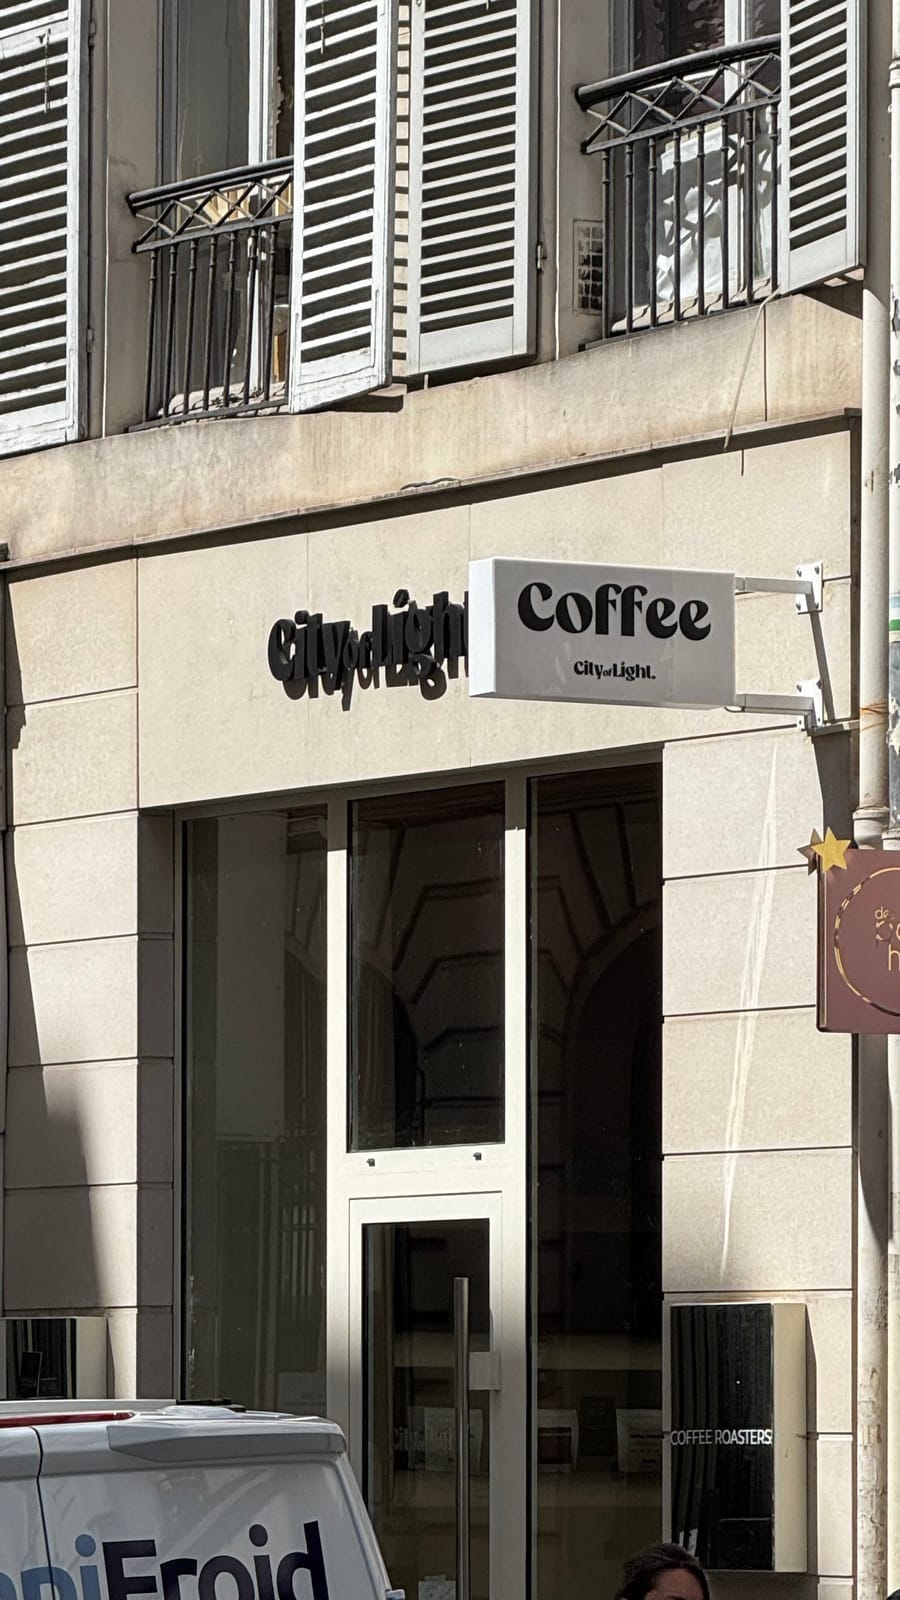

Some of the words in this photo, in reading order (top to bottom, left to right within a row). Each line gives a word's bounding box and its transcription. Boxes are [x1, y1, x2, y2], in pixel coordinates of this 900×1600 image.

[517, 582, 712, 641] Coffee
[670, 1429, 713, 1446] COFFEE
[714, 1428, 772, 1446] ROASTERS
